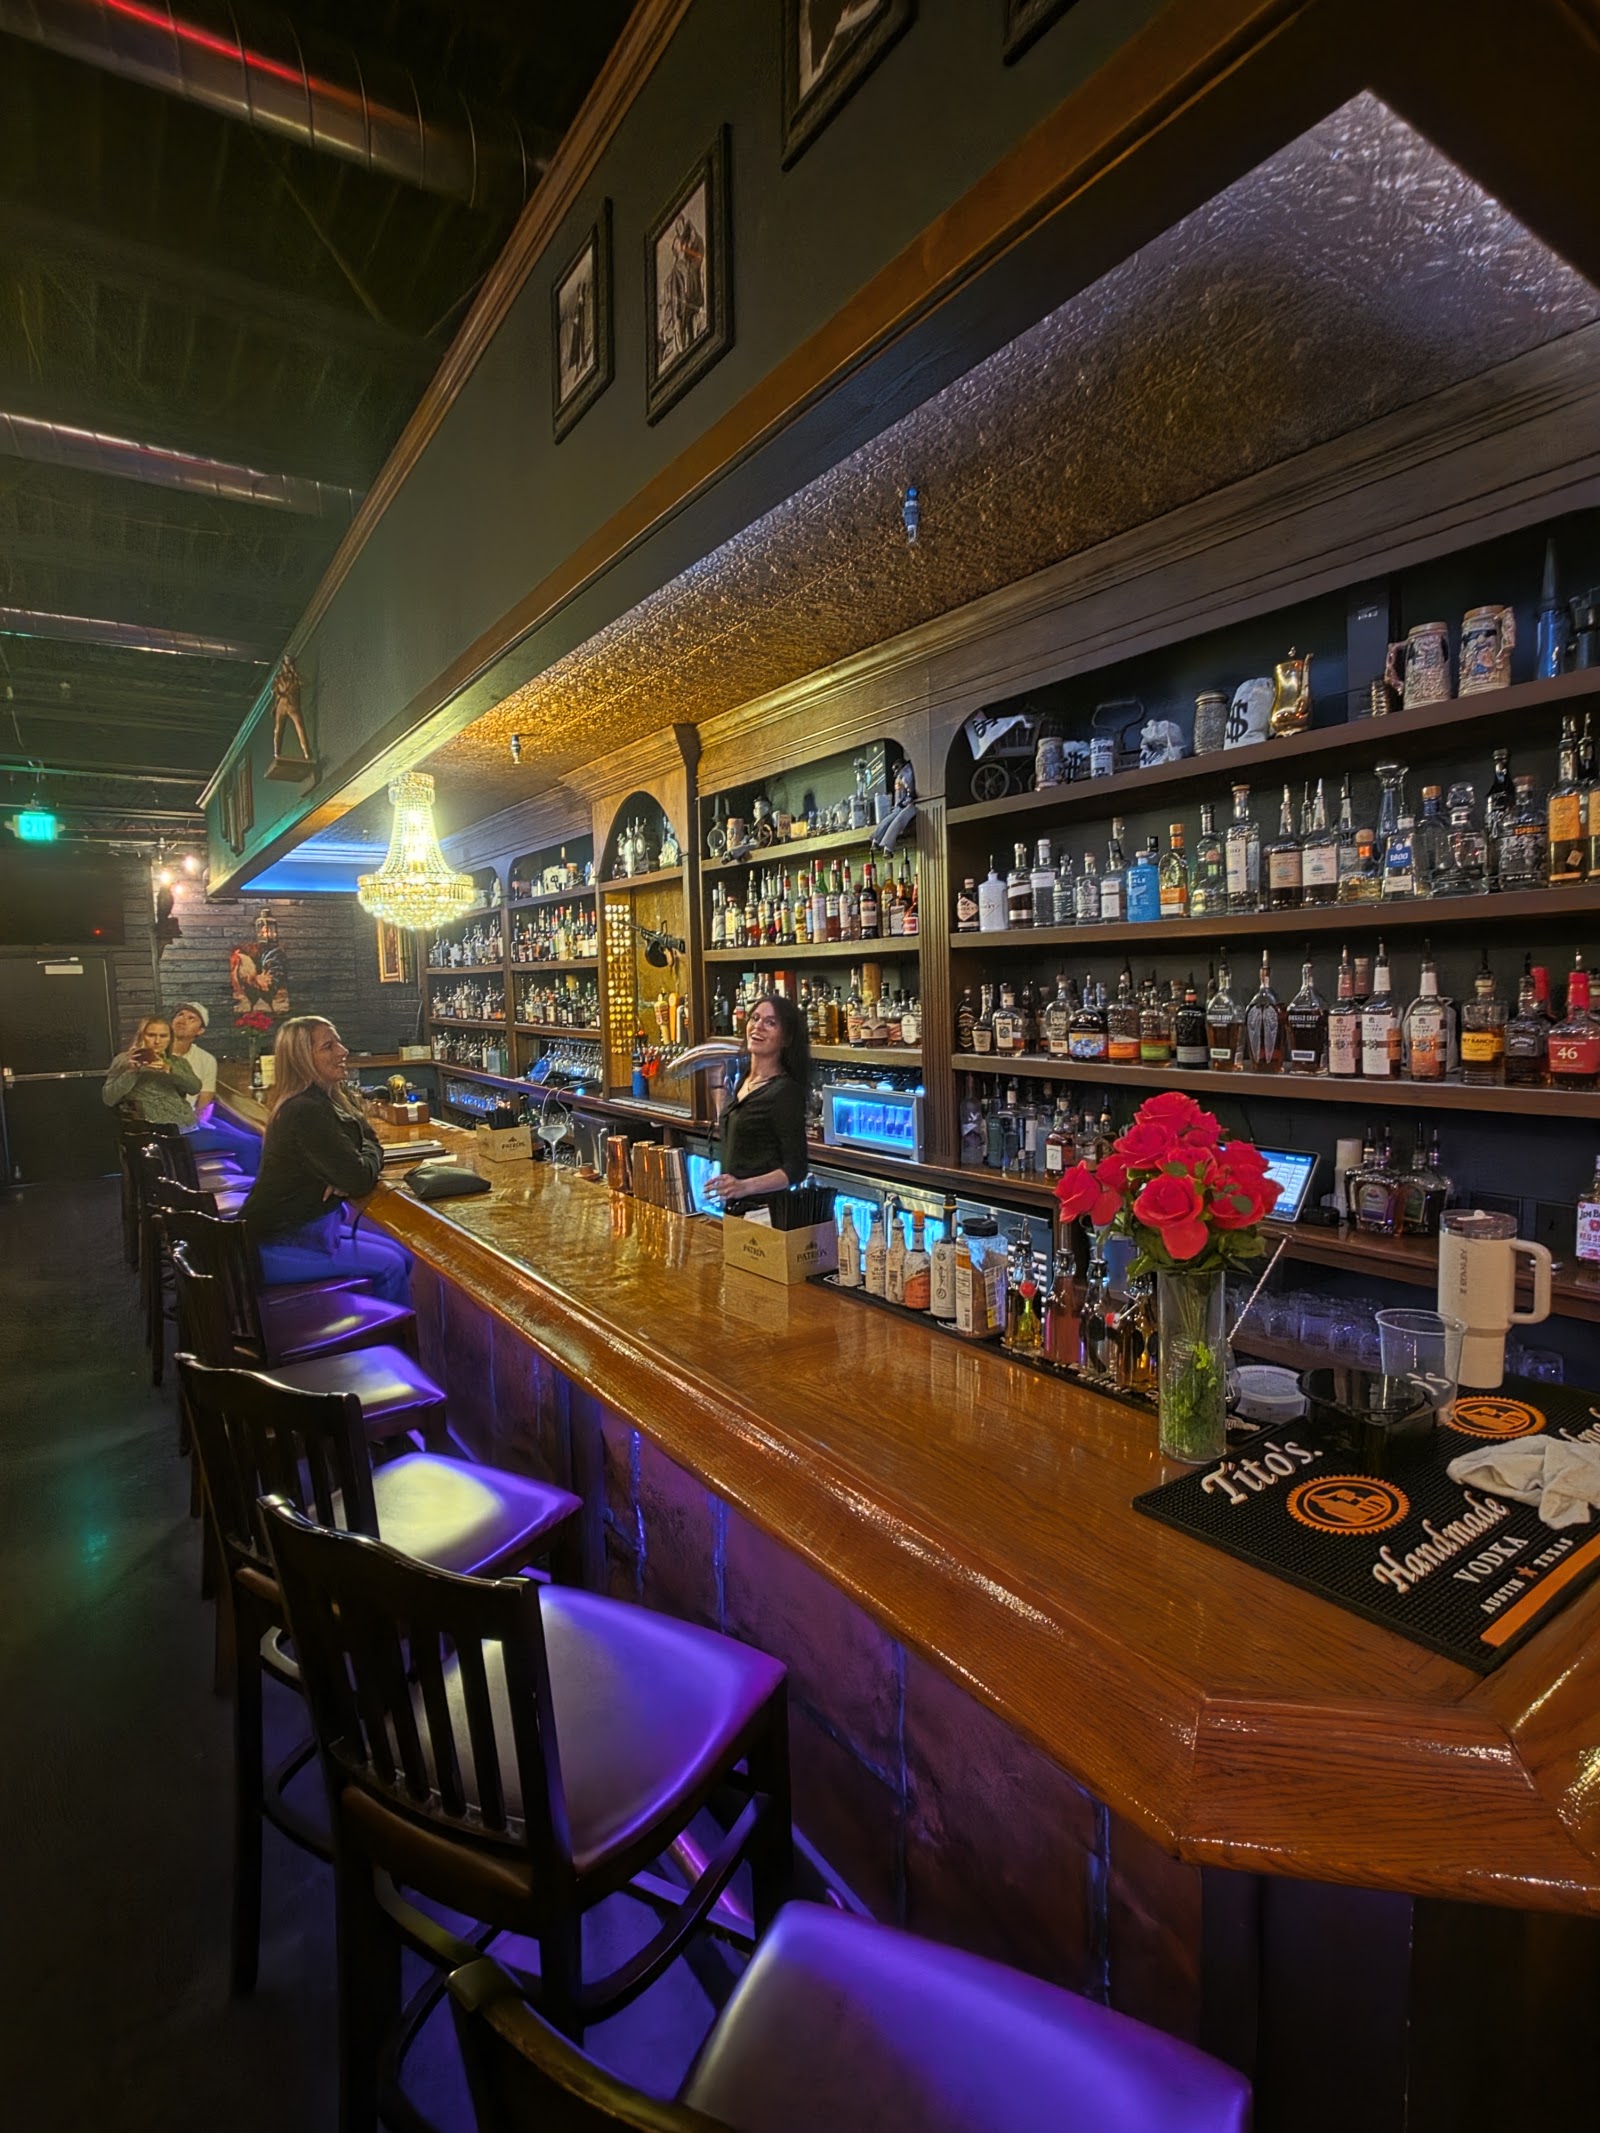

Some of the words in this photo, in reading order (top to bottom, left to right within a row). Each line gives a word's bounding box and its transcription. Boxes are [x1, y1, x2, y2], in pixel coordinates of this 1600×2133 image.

[1557, 1046, 1578, 1060] 46
[1372, 1490, 1511, 1595] Handmade
[1453, 1534, 1529, 1585] VODKA
[1480, 1577, 1526, 1615] AUSTIN
[1533, 1537, 1574, 1569] TEXAS
